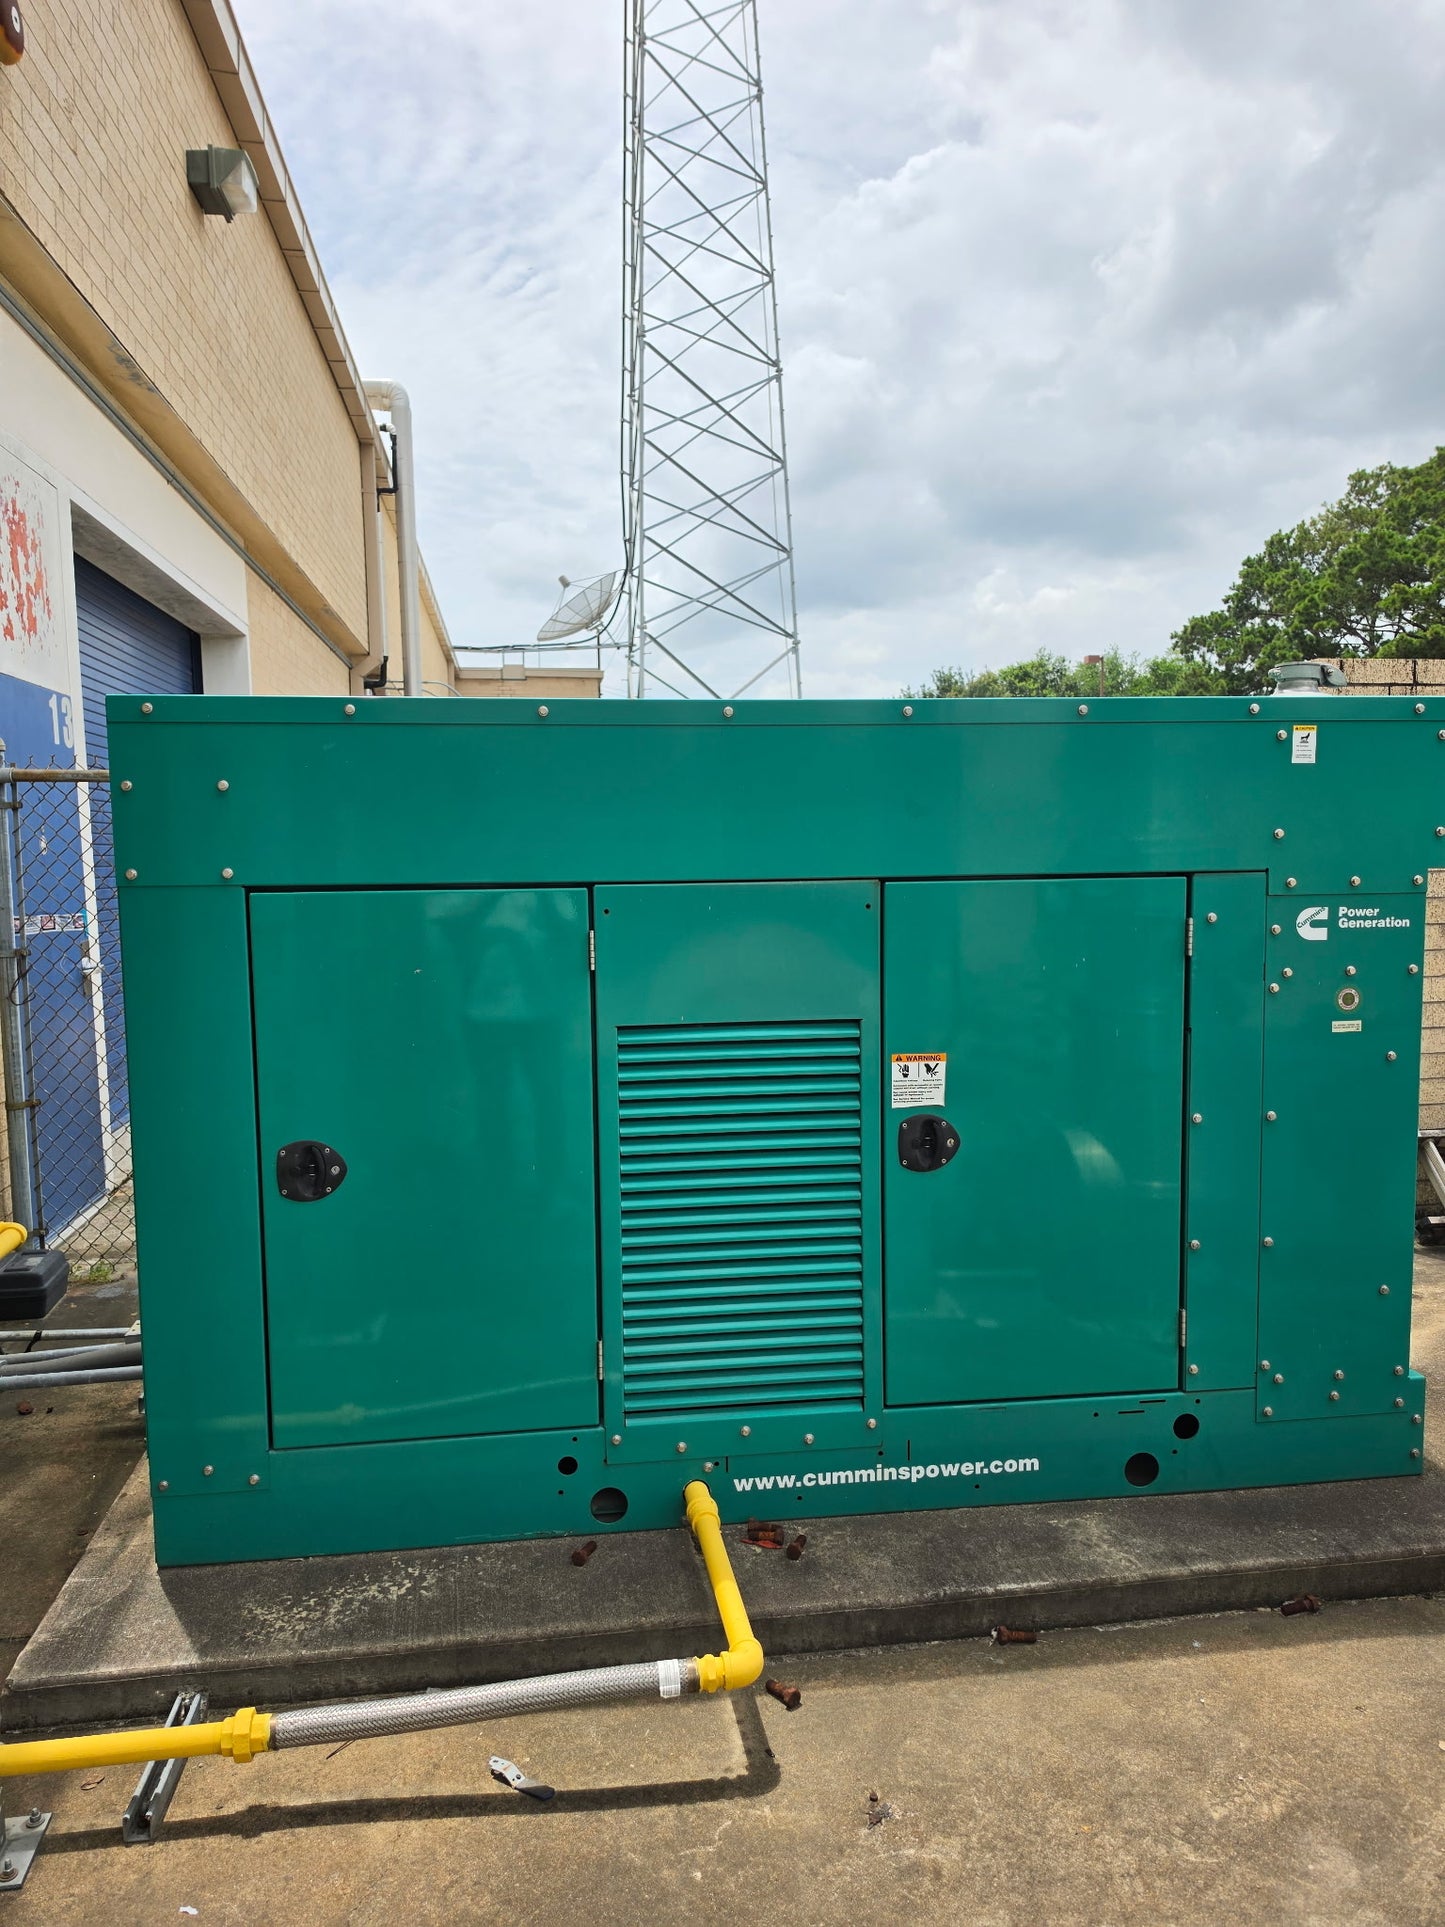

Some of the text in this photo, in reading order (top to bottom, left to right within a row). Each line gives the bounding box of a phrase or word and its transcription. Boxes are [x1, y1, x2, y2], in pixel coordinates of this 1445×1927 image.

[49, 693, 74, 749] 13
[1297, 907, 1326, 929] Cummins
[1338, 906, 1380, 917] Power
[1338, 917, 1410, 929] Generation
[733, 1456, 1040, 1492] www.cumminspower.com
